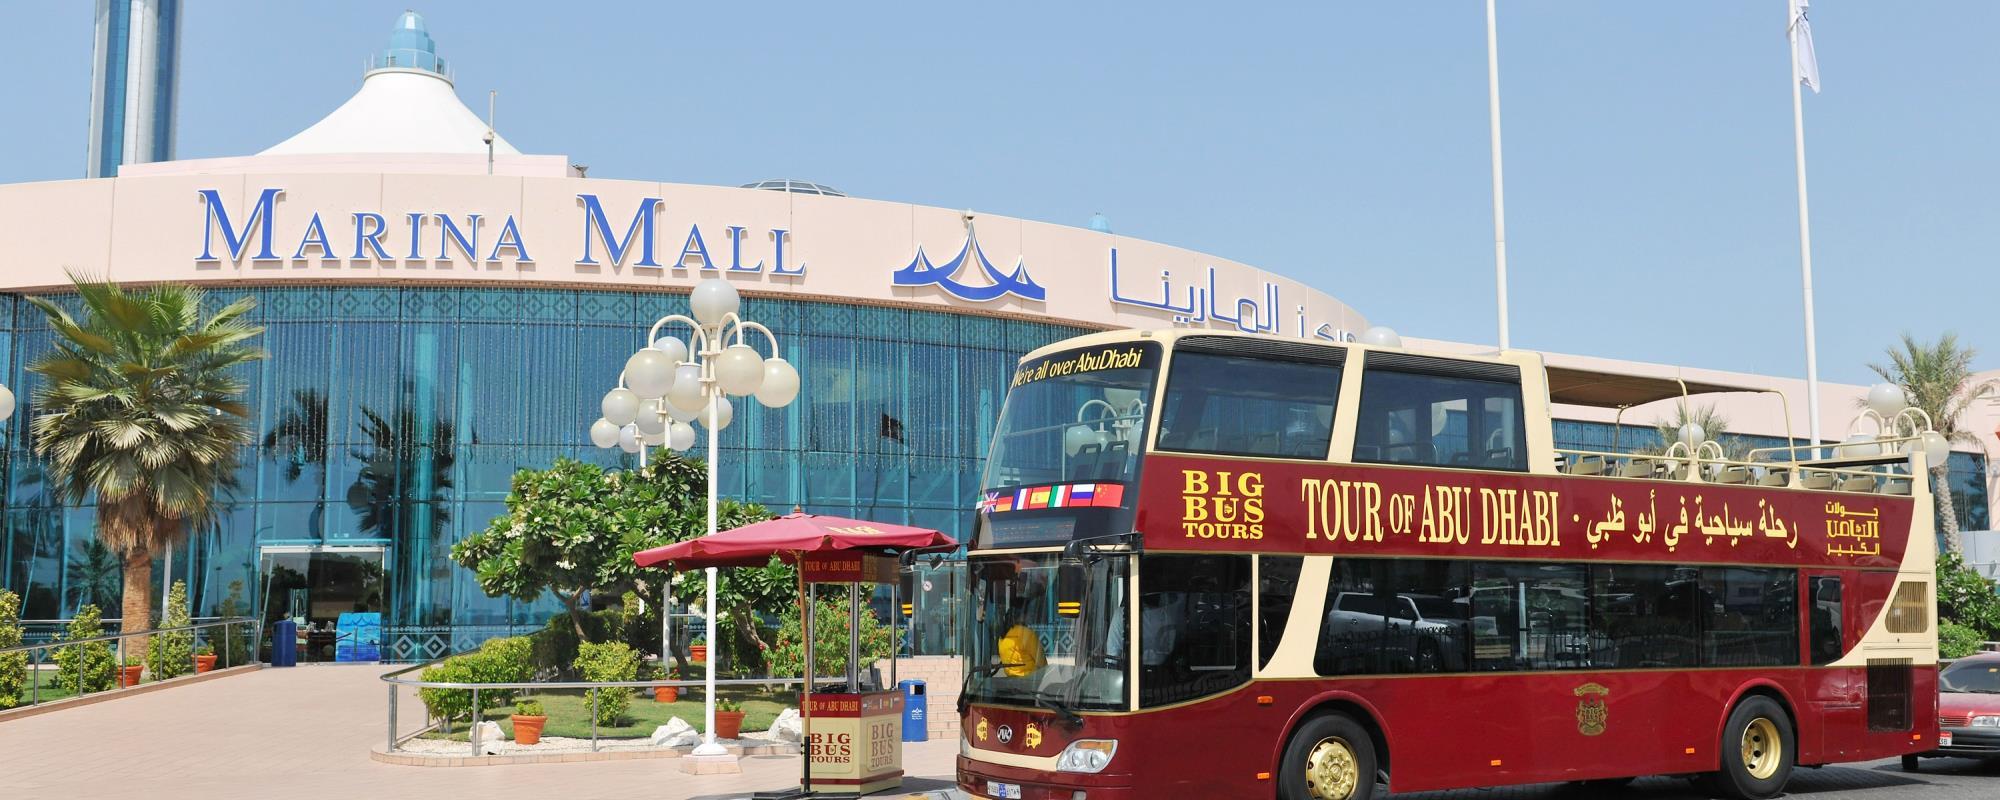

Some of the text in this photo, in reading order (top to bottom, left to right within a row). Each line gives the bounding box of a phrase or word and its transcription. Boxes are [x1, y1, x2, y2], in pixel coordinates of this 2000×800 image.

[194, 188, 808, 276] MARINA MALL
[1109, 248, 1279, 334] المارينا
[1034, 359, 1049, 381] all
[1049, 359, 1076, 378] over
[1182, 469, 1265, 497] BIG
[1182, 496, 1265, 523] BUS
[1301, 478, 1560, 547] TOUR OF ABU DHABI
[1586, 488, 1797, 552] رحلة سياحية في أبو ظبي
[1182, 522, 1264, 540] TOURS
[804, 561, 820, 571] TOUR
[829, 561, 840, 571] ABU
[842, 561, 860, 571] DHABI
[826, 701, 839, 711] ABU
[840, 701, 858, 711] DHABI
[810, 733, 851, 744] BIG
[872, 723, 893, 740] BIG
[810, 744, 851, 756] BUS
[872, 739, 894, 757] BUS
[810, 756, 850, 764] TOURS
[872, 755, 893, 767] TOURS
